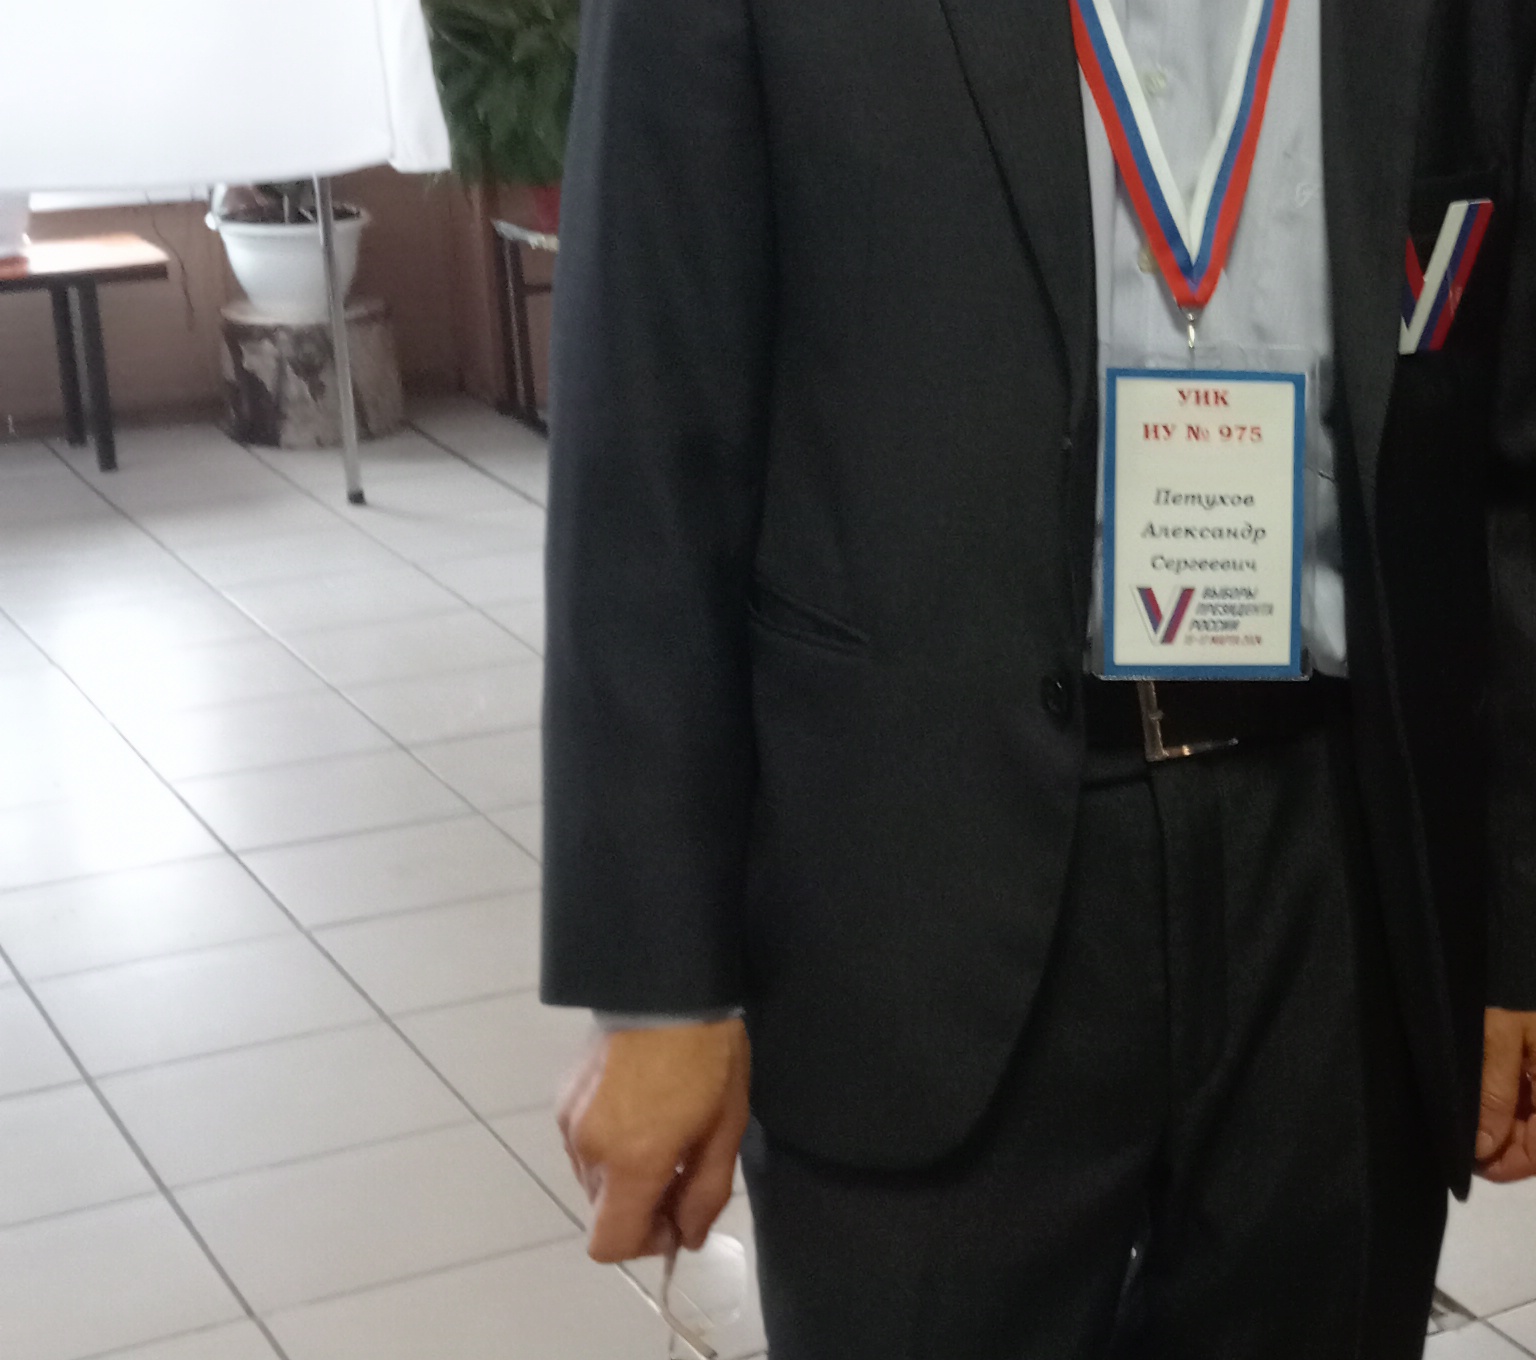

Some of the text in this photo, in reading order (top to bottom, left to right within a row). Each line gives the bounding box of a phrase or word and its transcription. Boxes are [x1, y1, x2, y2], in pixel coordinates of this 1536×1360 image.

[1178, 388, 1230, 407] УИК
[1187, 423, 1210, 441] №
[1218, 424, 1262, 442] 975
[1153, 487, 1256, 511] Петухов
[1140, 520, 1268, 544] Александр
[1150, 554, 1257, 575] Сергеевич
